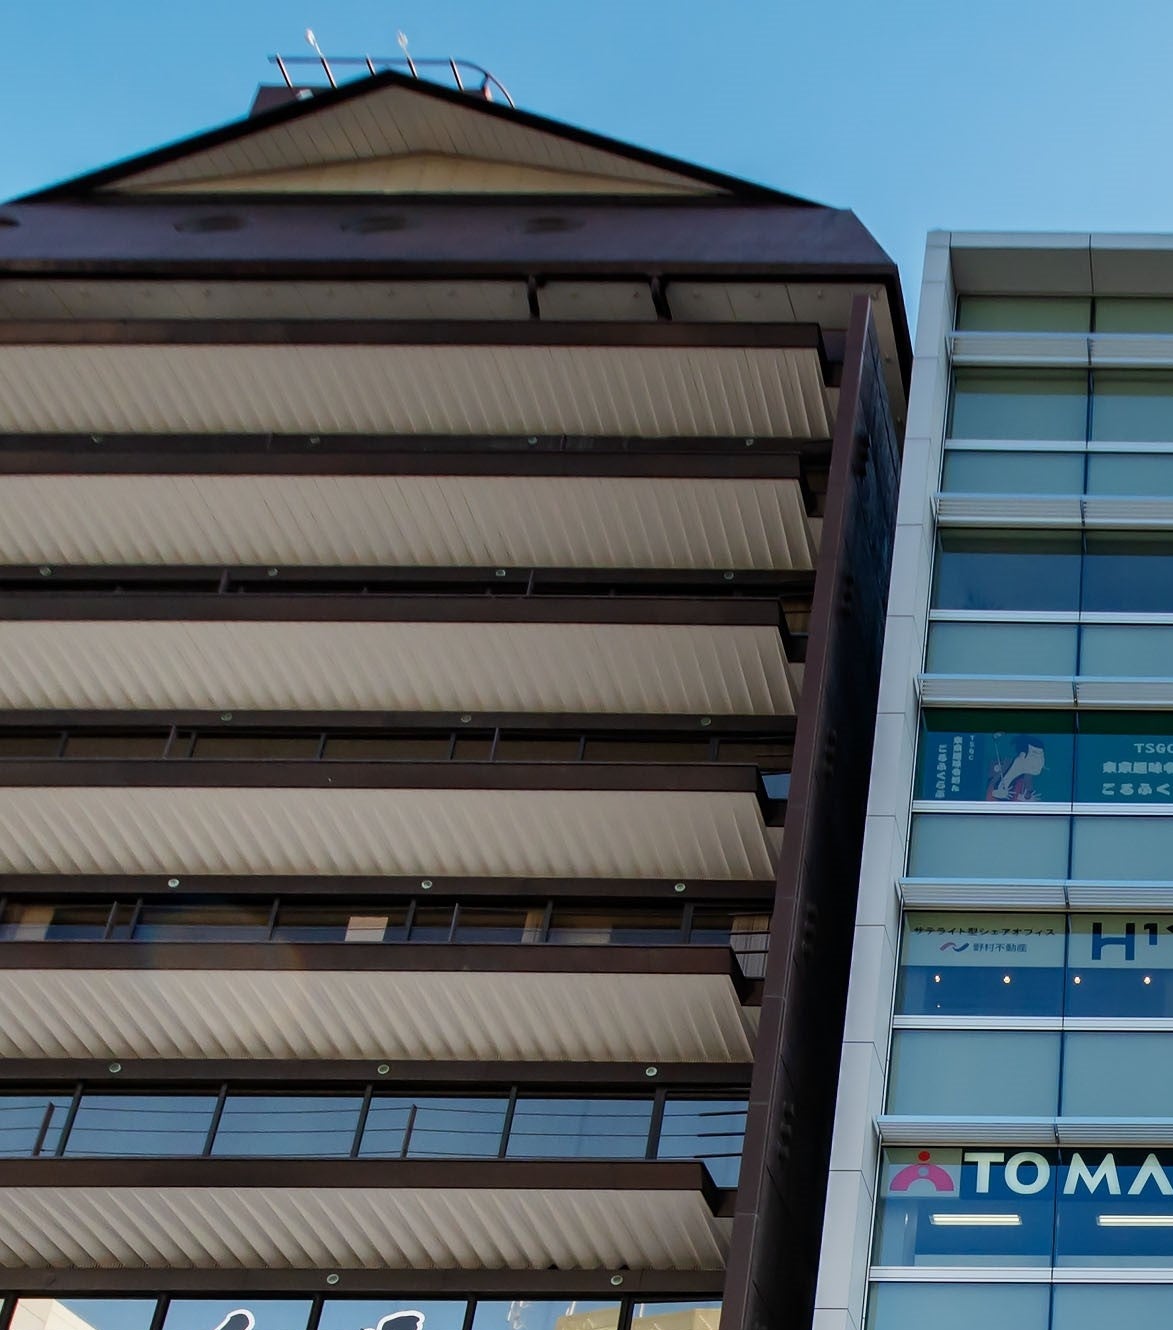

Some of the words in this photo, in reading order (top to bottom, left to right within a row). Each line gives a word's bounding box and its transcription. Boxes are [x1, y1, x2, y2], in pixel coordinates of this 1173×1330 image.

[913, 926, 1056, 937] サテライト型シェアオフィス
[972, 943, 1027, 953] 野村不動産
